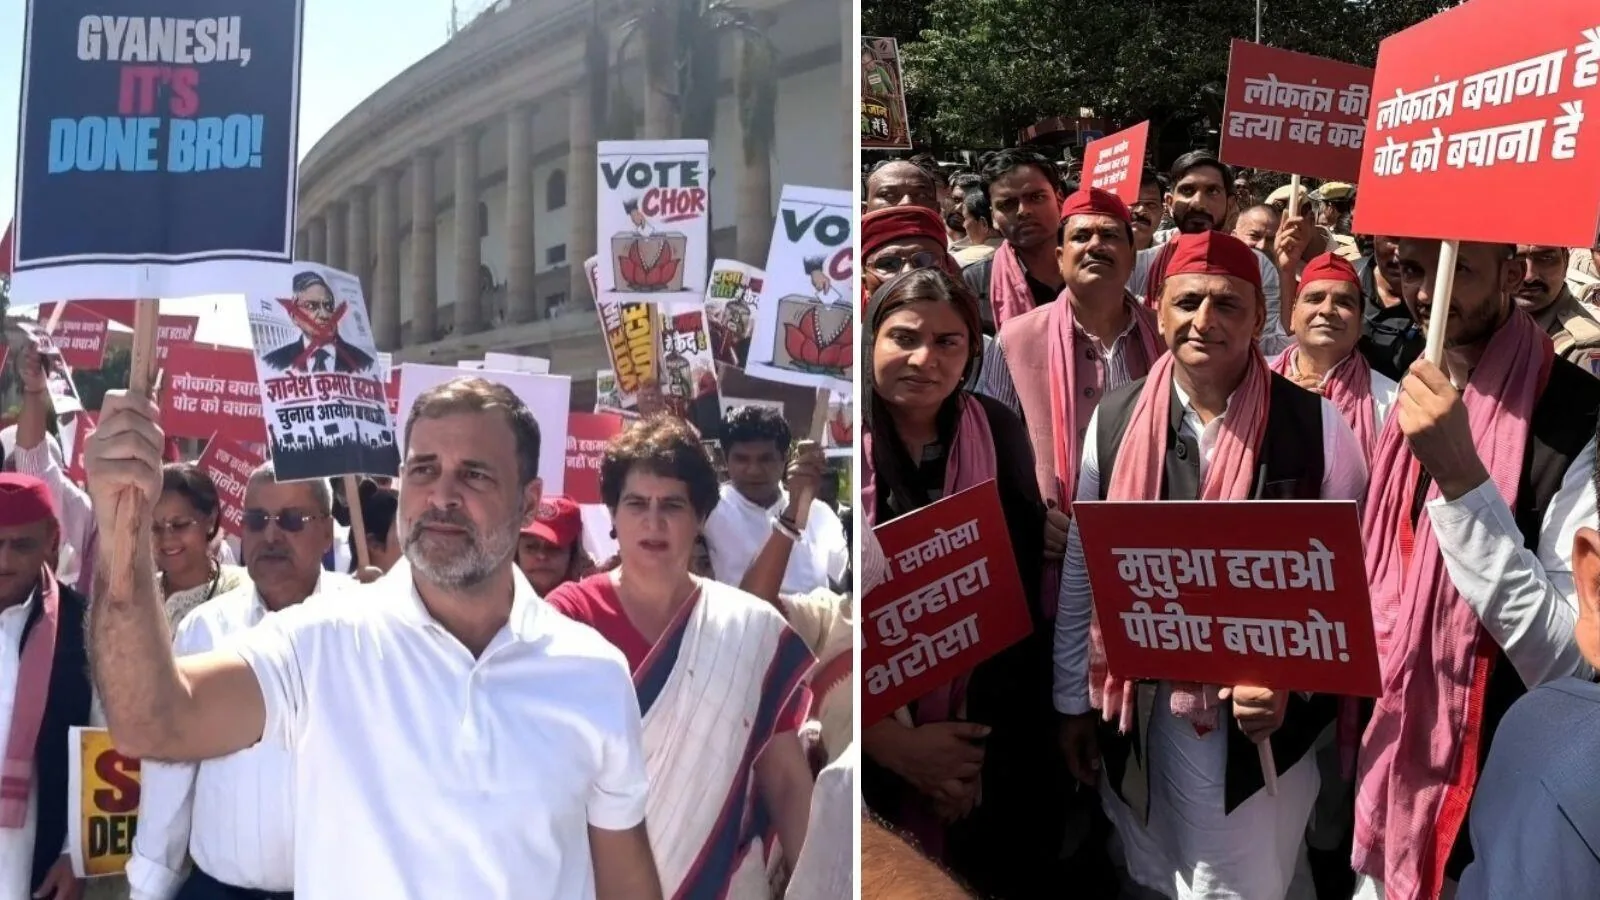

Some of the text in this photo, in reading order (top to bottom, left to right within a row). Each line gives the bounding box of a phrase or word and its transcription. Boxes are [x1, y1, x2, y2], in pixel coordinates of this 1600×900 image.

[77, 15, 251, 67] GYANESH,
[118, 65, 200, 117] IT'S
[1244, 73, 1370, 117] लोकतंत्र की
[1375, 26, 1600, 131] लोकतंत्र बचाना है
[48, 114, 264, 174] DONE BRO!
[1229, 111, 1285, 141] हत्या
[1289, 111, 1325, 145] बंद
[1373, 100, 1584, 177] वोट को बचाना है
[601, 156, 703, 189] VOTE
[641, 187, 706, 217] CHOR
[620, 302, 651, 383] VOICE
[172, 372, 226, 394] लोकतंत्र
[172, 392, 198, 412] वोट
[201, 395, 221, 414] को
[264, 370, 314, 402] ज्ञानेश
[313, 373, 353, 401] कुमार
[275, 403, 314, 430] चुनाव
[895, 518, 981, 574] समोसा
[1112, 538, 1336, 600] मुचुआ हटाओ
[868, 557, 991, 647] तुम्हारा
[865, 613, 981, 695] भरोसा
[1119, 601, 1350, 664] पीडीए बचाओ!
